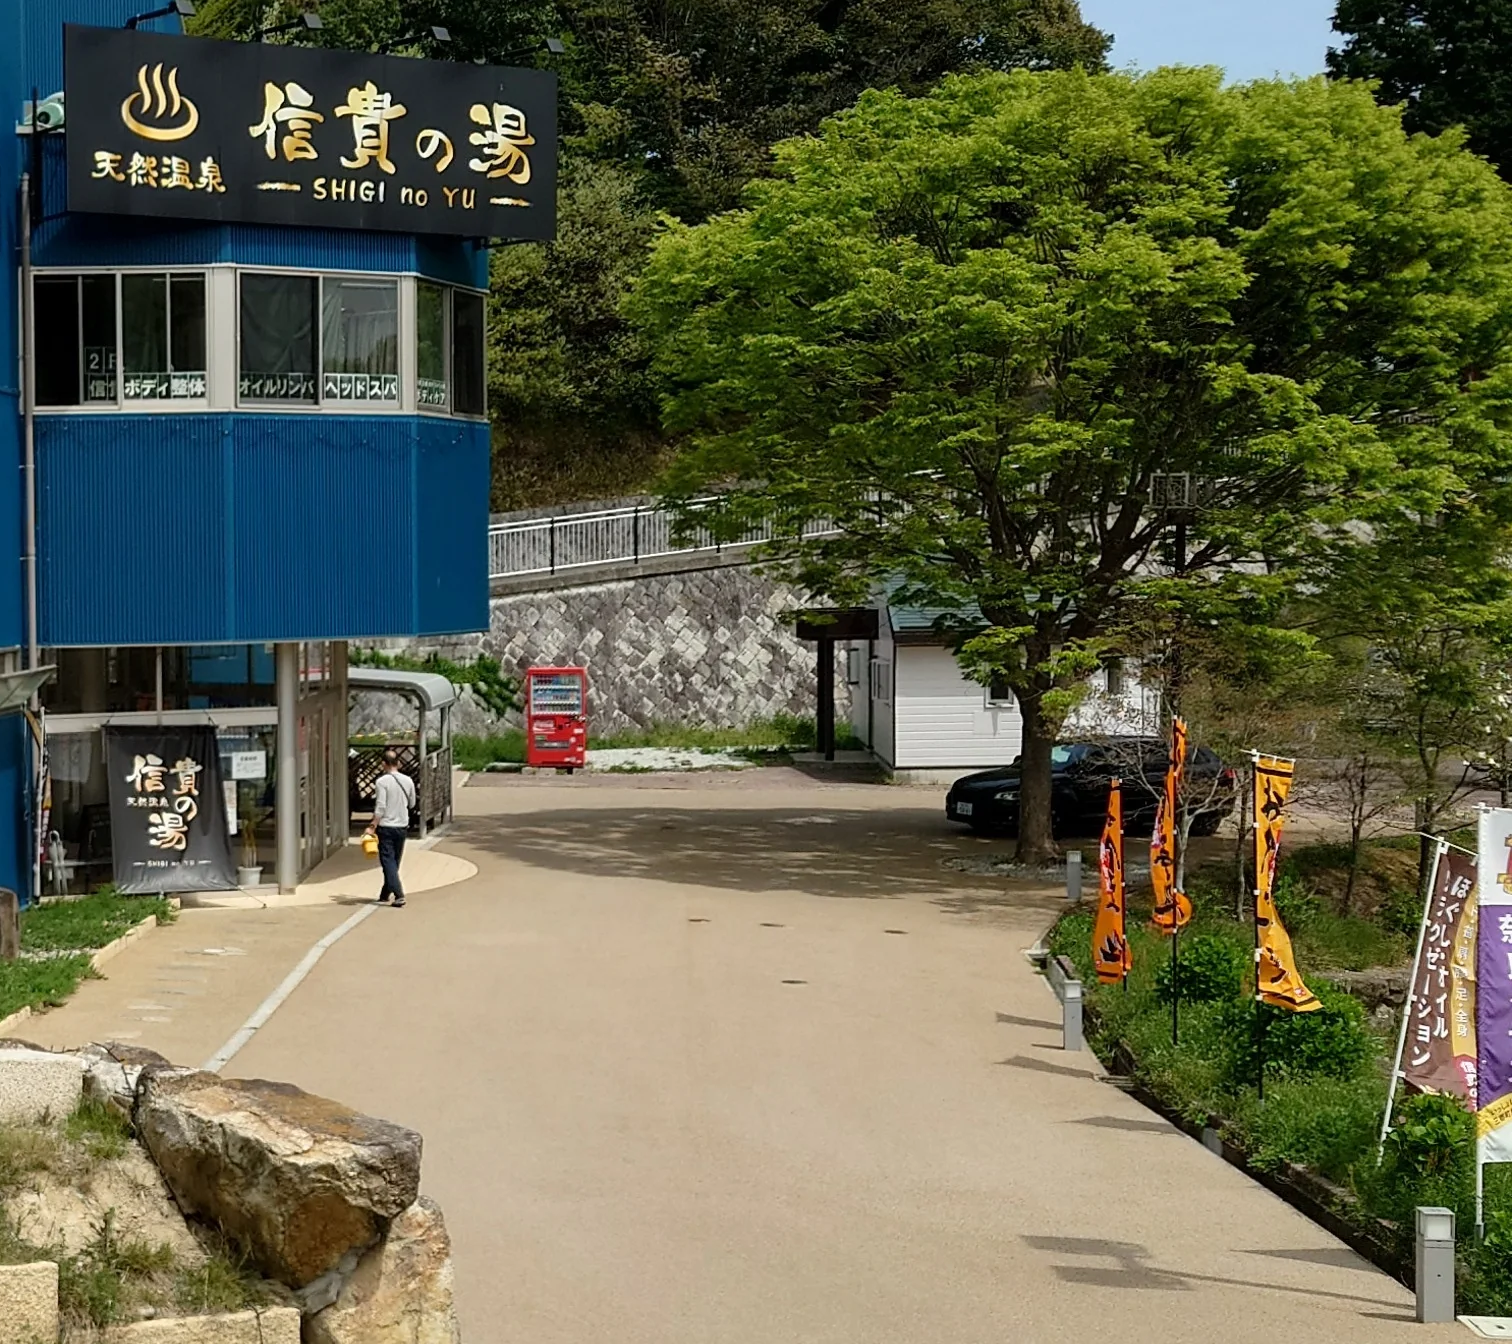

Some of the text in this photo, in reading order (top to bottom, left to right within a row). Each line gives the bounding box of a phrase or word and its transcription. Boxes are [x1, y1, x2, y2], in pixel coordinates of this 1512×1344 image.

[248, 81, 536, 185] 信貴の湯
[91, 150, 226, 194] 天然温泉
[312, 177, 476, 209] SHIGI no YU
[124, 376, 206, 397] ボディ整体
[239, 377, 315, 396] オイルリンパ
[325, 380, 397, 397] ヘッドスパ
[125, 753, 203, 850] 信貴の湯
